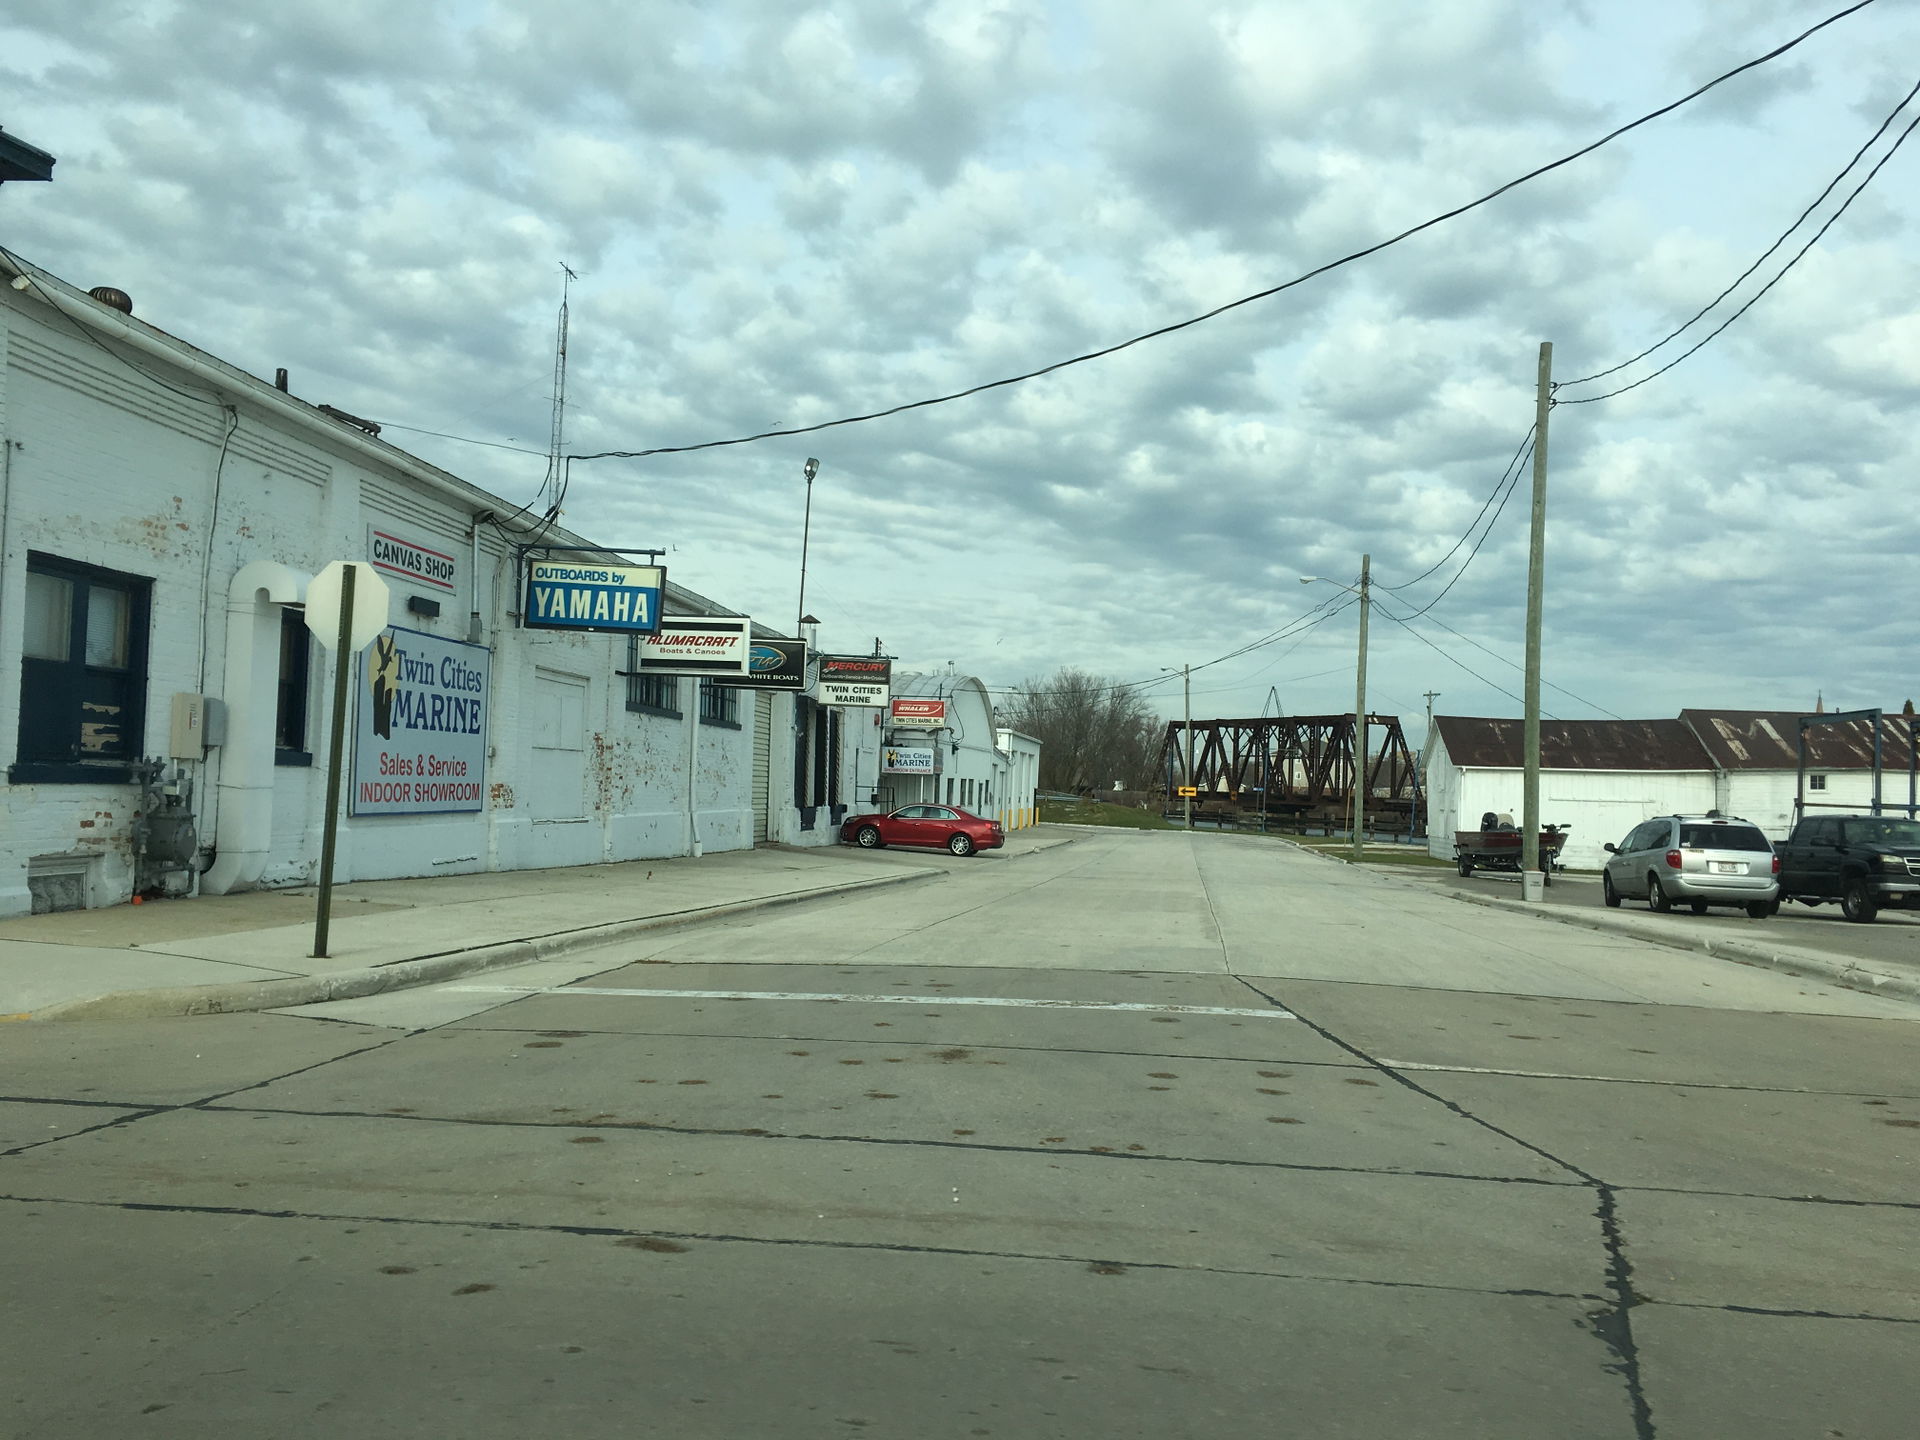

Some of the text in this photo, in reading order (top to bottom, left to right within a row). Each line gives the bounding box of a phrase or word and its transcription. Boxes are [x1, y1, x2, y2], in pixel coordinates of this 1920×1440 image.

[374, 539, 454, 580] CANVAS SHOP
[535, 567, 626, 585] OUTBOARDS by
[535, 587, 649, 623] YAMAHA
[647, 635, 739, 647] ALUMACRAFT
[394, 649, 482, 693] Twin Cities
[826, 661, 887, 671] MERCURY
[825, 685, 882, 694] TWIN CITIES
[835, 695, 871, 703] MARINE
[392, 689, 481, 735] MARINE
[380, 752, 467, 776] Sales & Service
[894, 759, 931, 767] MARINE
[360, 783, 480, 803] INDOOR SHOWROOM
